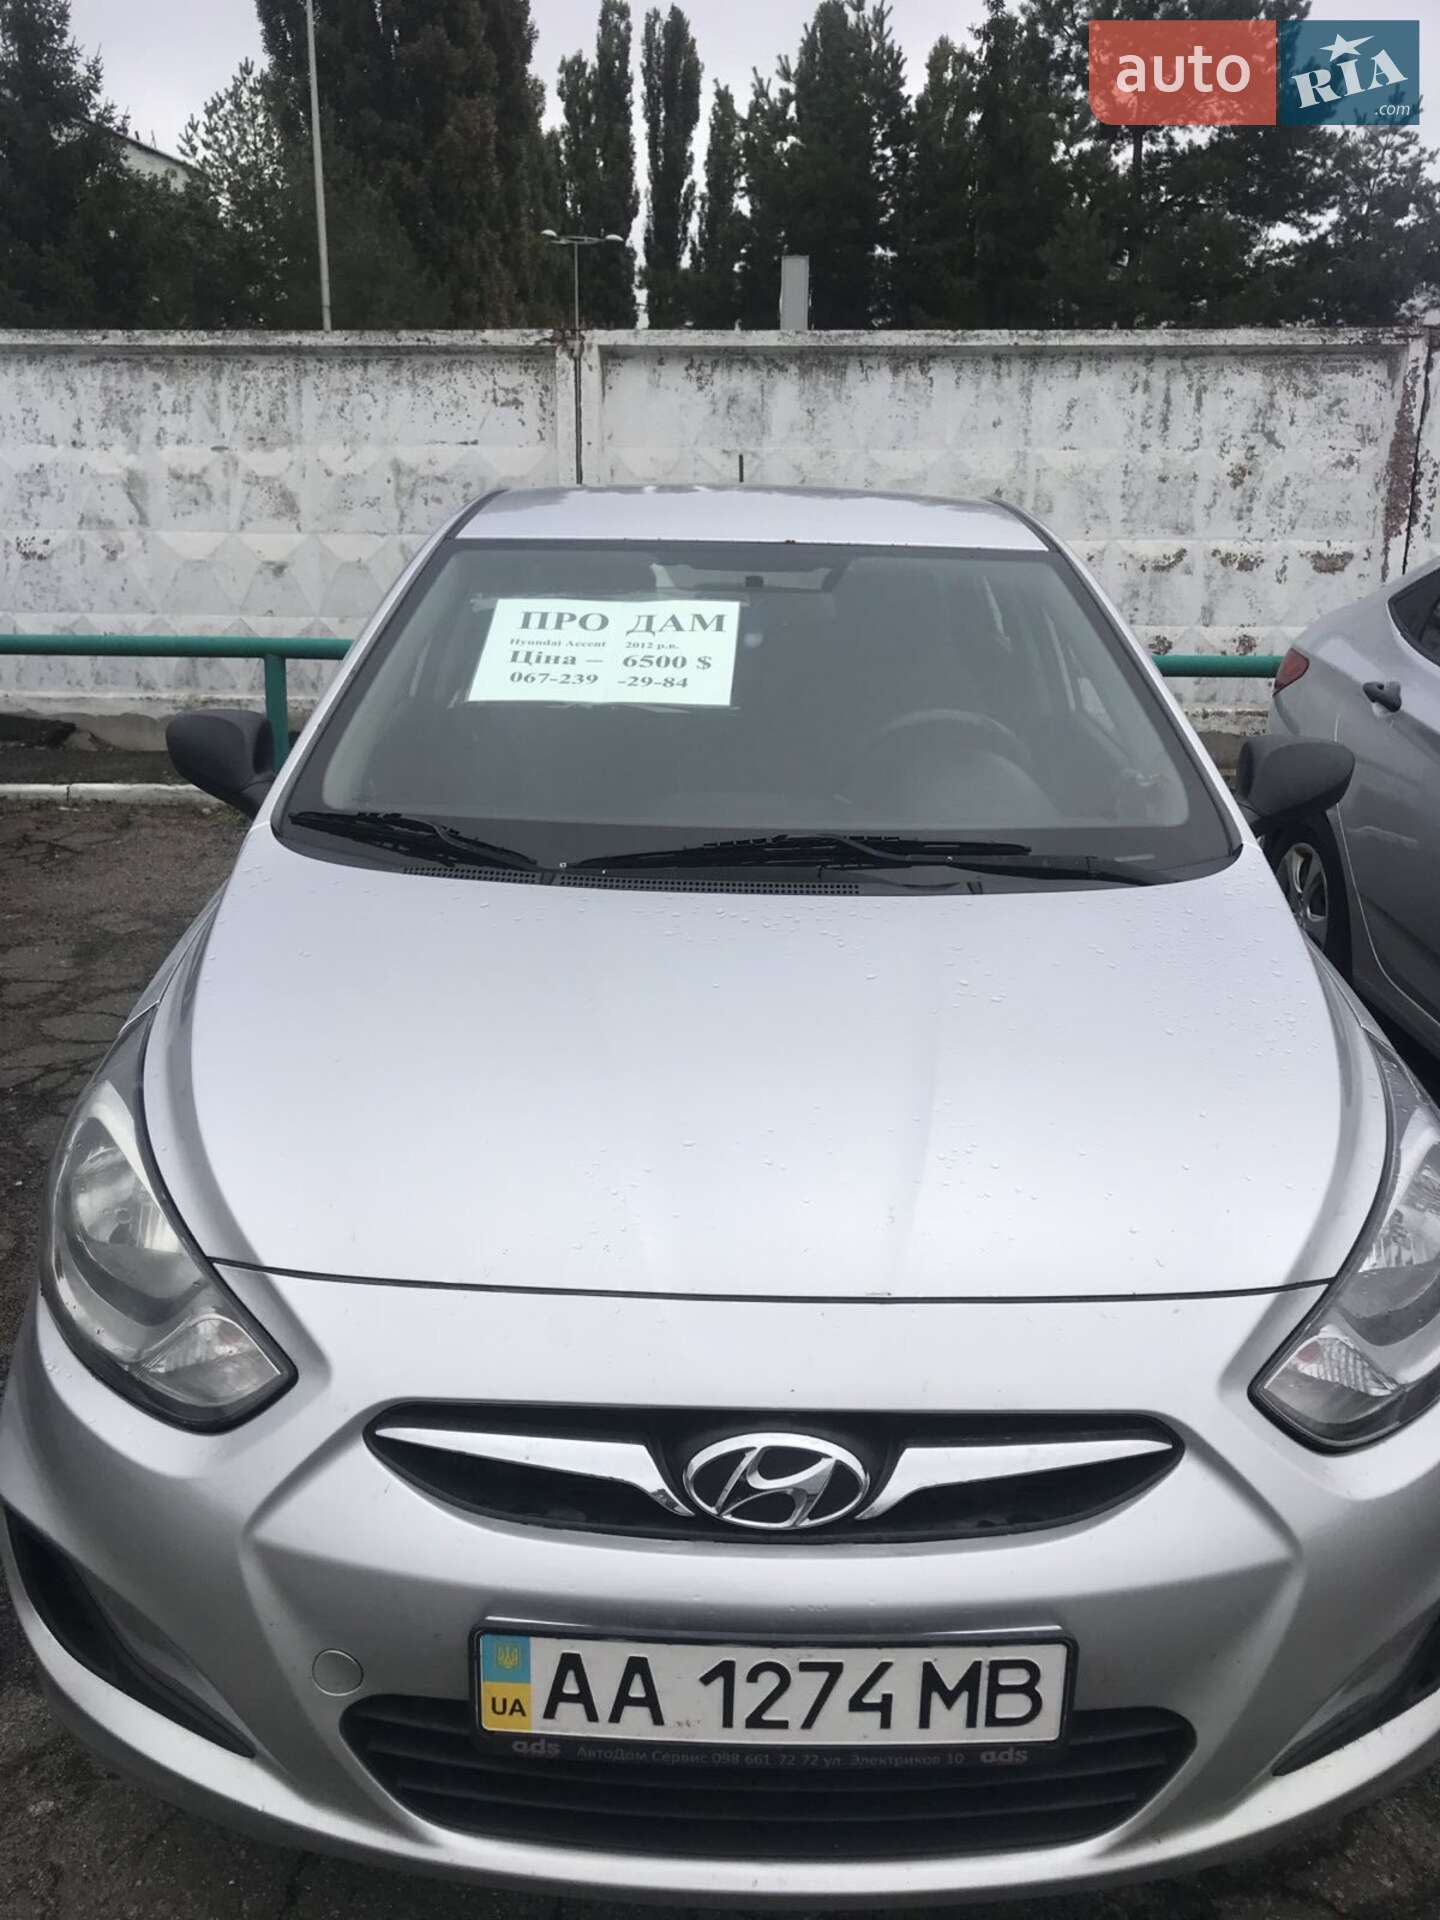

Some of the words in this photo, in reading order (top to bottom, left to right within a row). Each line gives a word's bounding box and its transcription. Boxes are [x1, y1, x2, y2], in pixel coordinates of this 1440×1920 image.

[519, 611, 609, 632] ПРО
[626, 613, 727, 637] ДАМ
[509, 637, 562, 648] Hyundai
[565, 639, 606, 648] Accent
[625, 641, 654, 650] 2012
[509, 650, 577, 666] Ціна
[622, 655, 687, 669] 6500
[696, 655, 712, 670] $
[509, 671, 599, 685] 067-239
[617, 676, 688, 688] -29-84
[543, 1652, 664, 1726] AA
[700, 1659, 894, 1730] 1274
[918, 1658, 1043, 1729] MB
[491, 1697, 527, 1717] UA
[512, 1738, 560, 1757] ads
[980, 1745, 1028, 1763] ads
